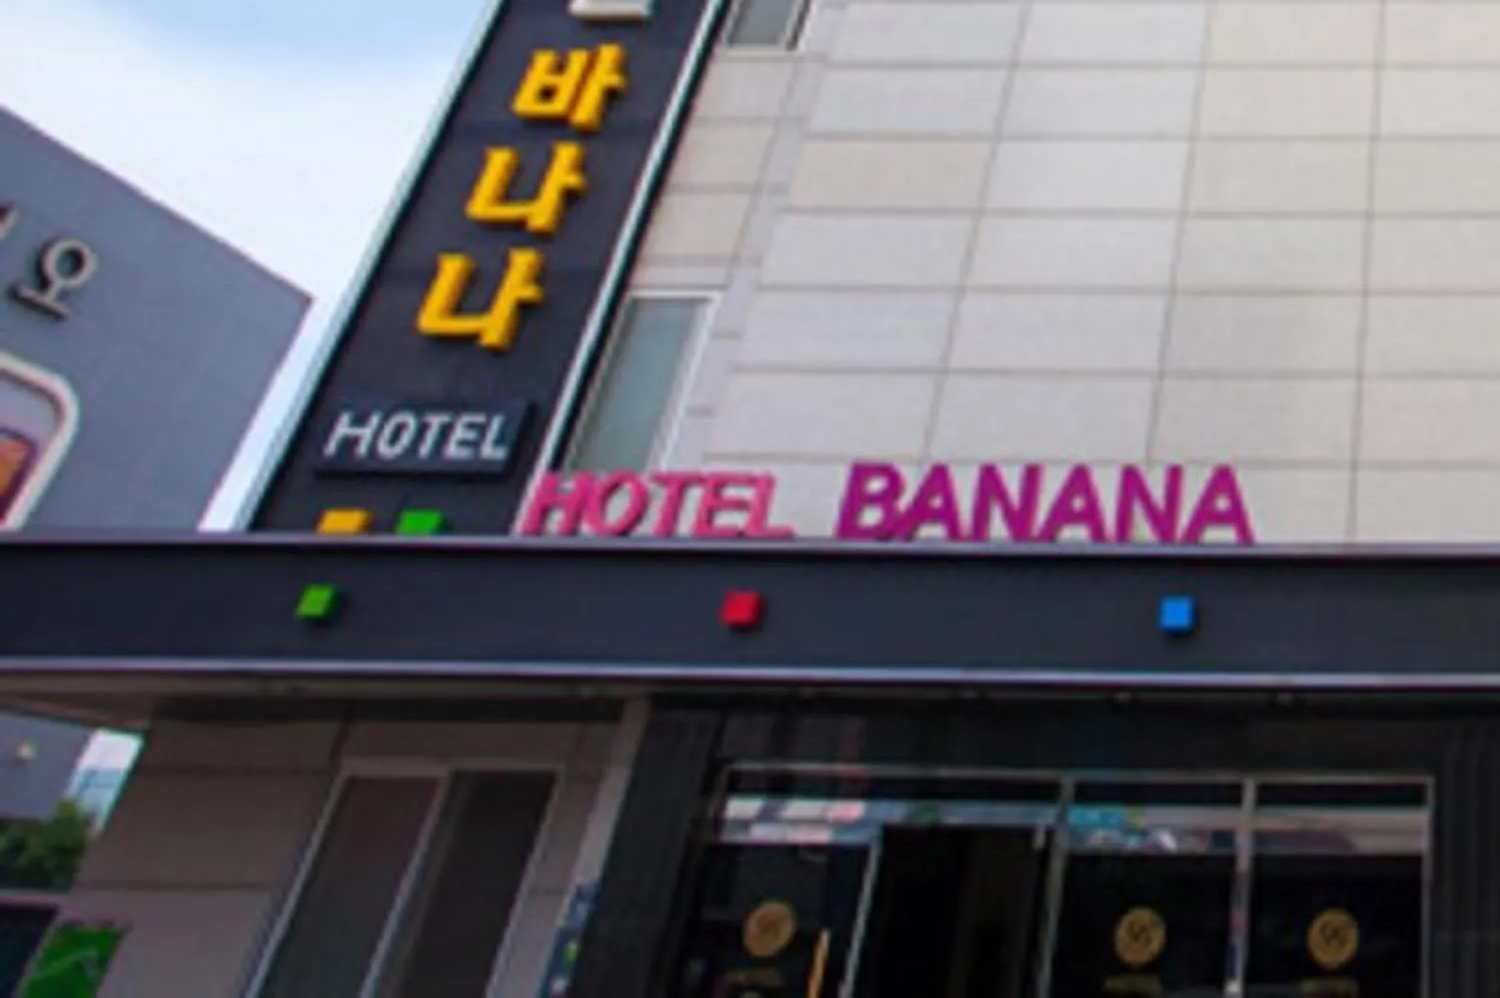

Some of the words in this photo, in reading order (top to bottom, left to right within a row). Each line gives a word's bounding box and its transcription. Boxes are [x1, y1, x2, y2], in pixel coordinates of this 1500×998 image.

[415, 42, 628, 351] 바나나
[0, 206, 97, 320] 오
[322, 410, 511, 462] HOTEL
[517, 471, 795, 538] HOTEL
[836, 461, 1254, 546] BANANA
